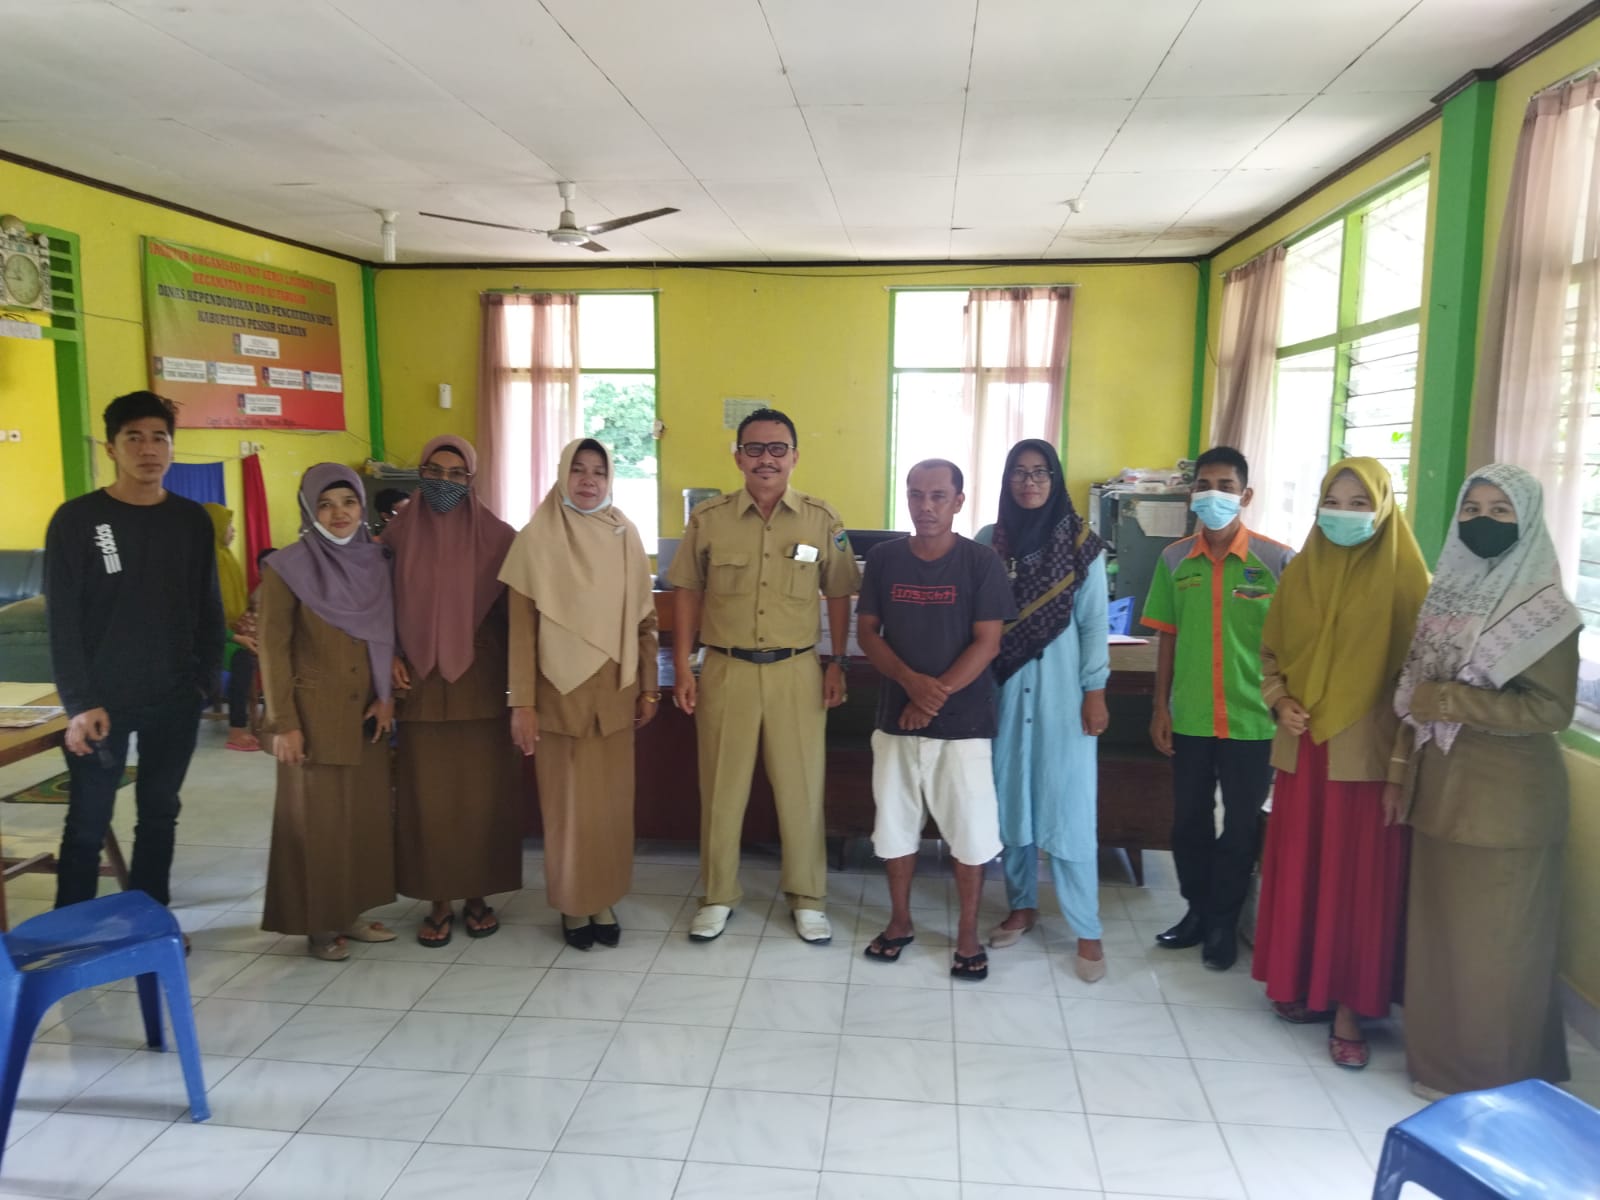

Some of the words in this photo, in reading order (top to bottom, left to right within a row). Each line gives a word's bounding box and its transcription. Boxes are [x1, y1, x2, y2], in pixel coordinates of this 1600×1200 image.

[158, 283, 185, 300] DINAS
[187, 289, 254, 312] KEPENDUDUKAN
[255, 302, 271, 316] DAN
[271, 305, 317, 323] PENCATATAN
[197, 310, 246, 328] KABUPATEN
[247, 318, 276, 333] PESISIR
[277, 323, 308, 337] SELATAN
